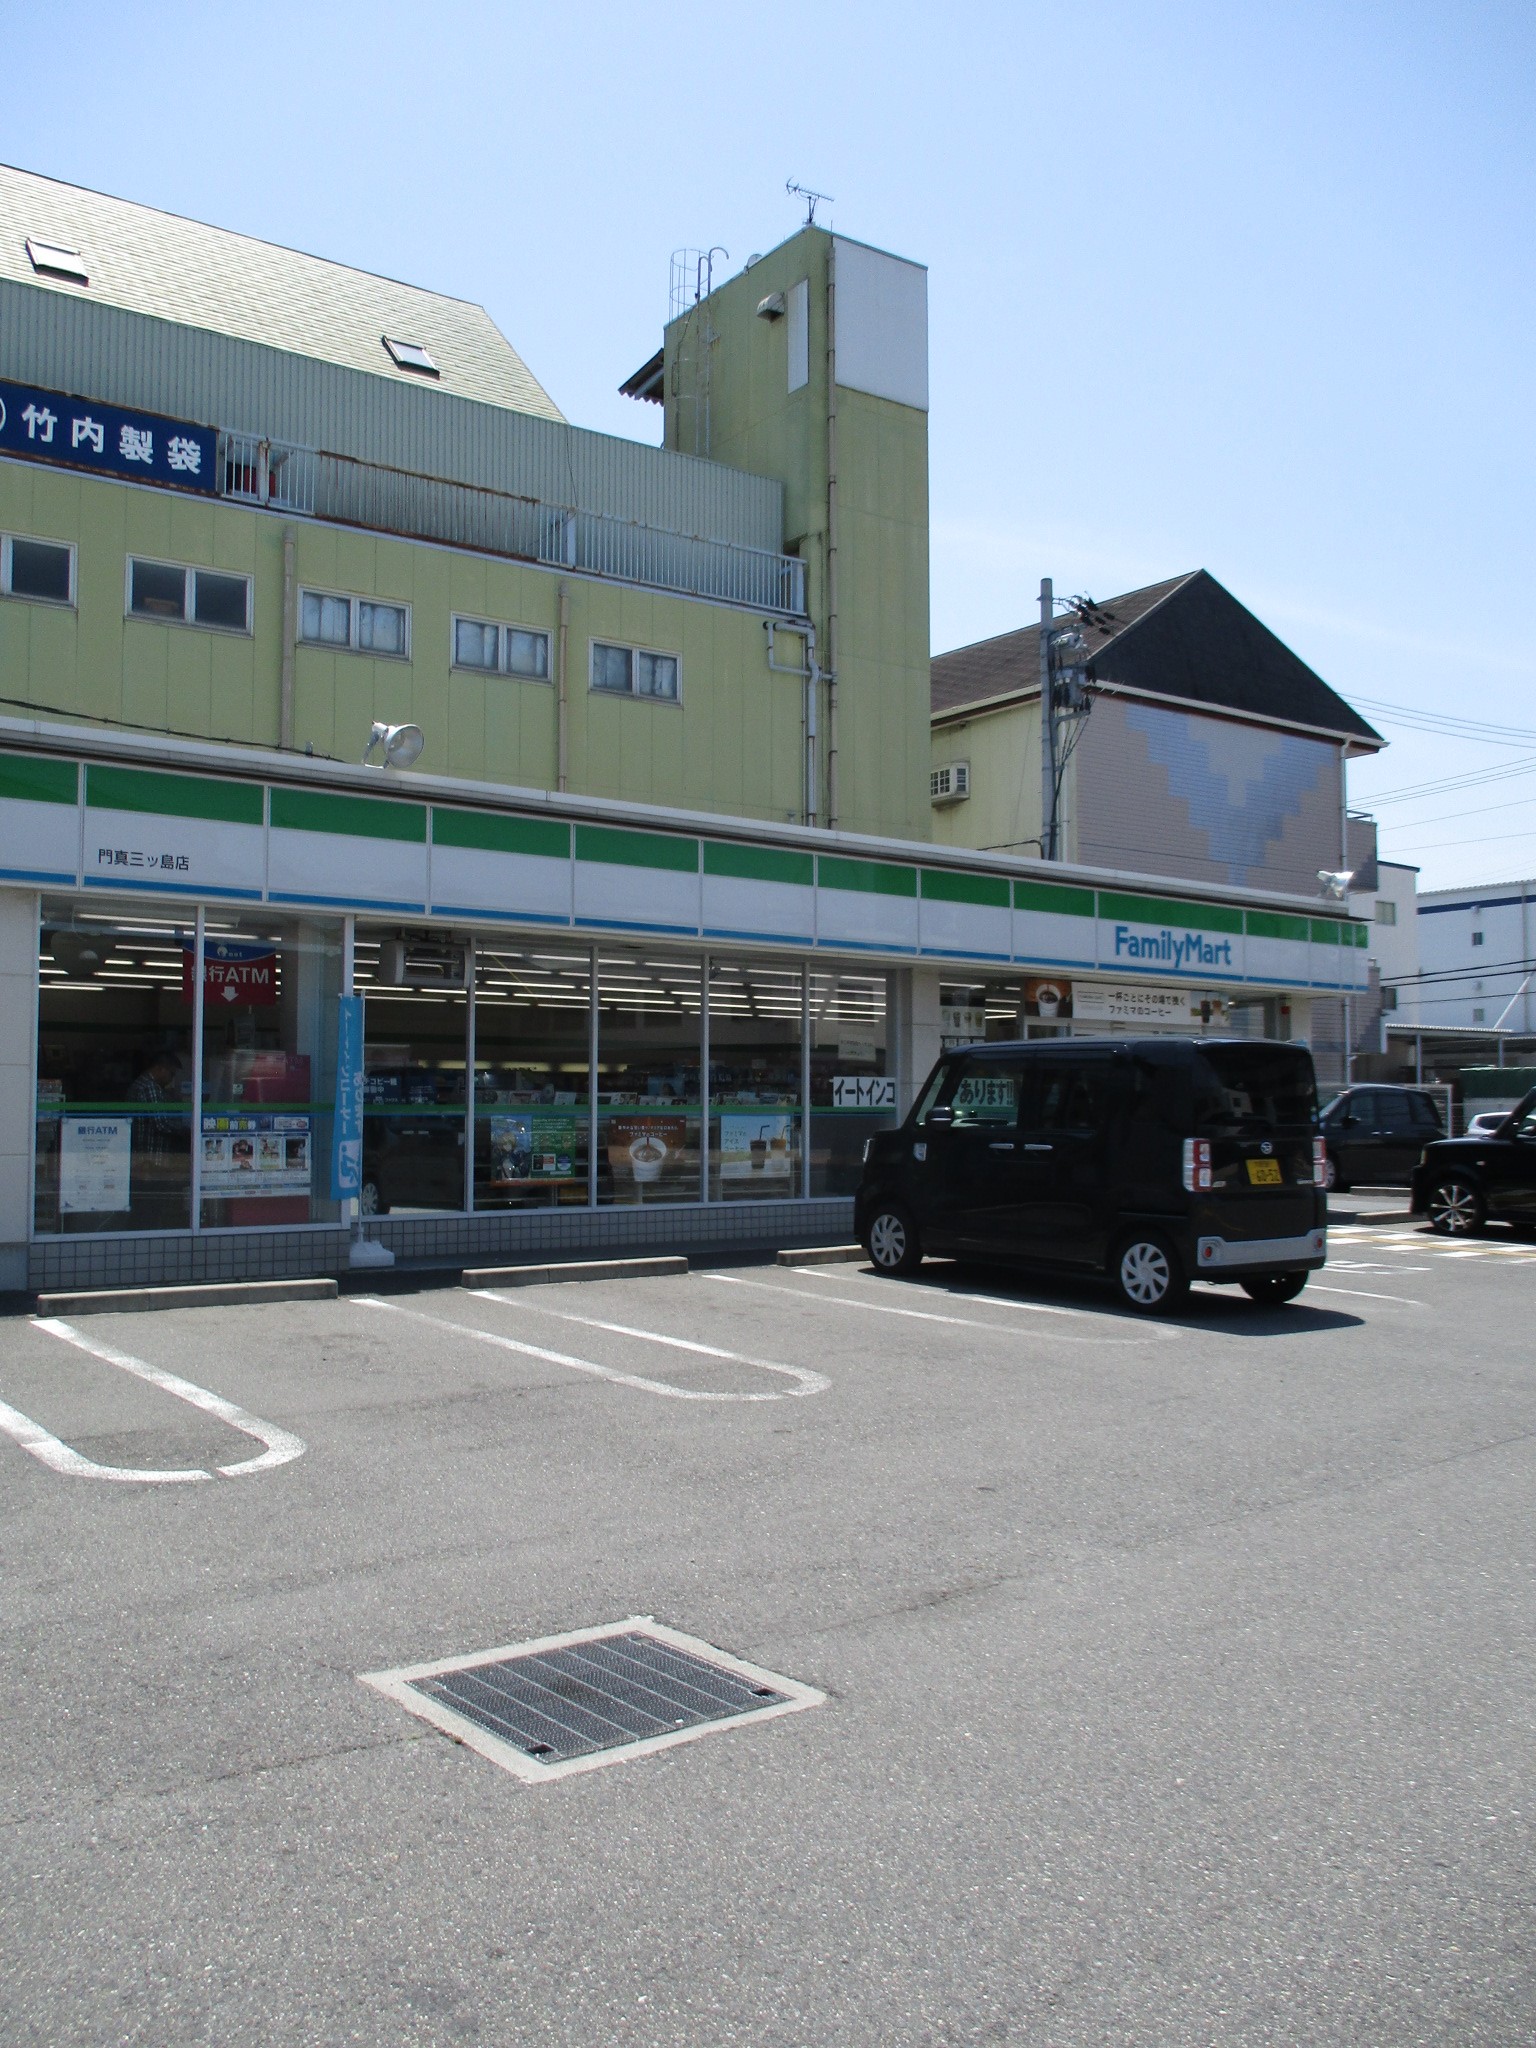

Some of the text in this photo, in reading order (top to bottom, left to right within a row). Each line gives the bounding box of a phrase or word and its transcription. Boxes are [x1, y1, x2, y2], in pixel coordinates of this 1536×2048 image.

[21, 403, 202, 475] 竹内製袋
[1115, 925, 1232, 969] FamilyMart
[1107, 1005, 1172, 1017] ファミマのコーヒー
[834, 1078, 896, 1106] イートインコ
